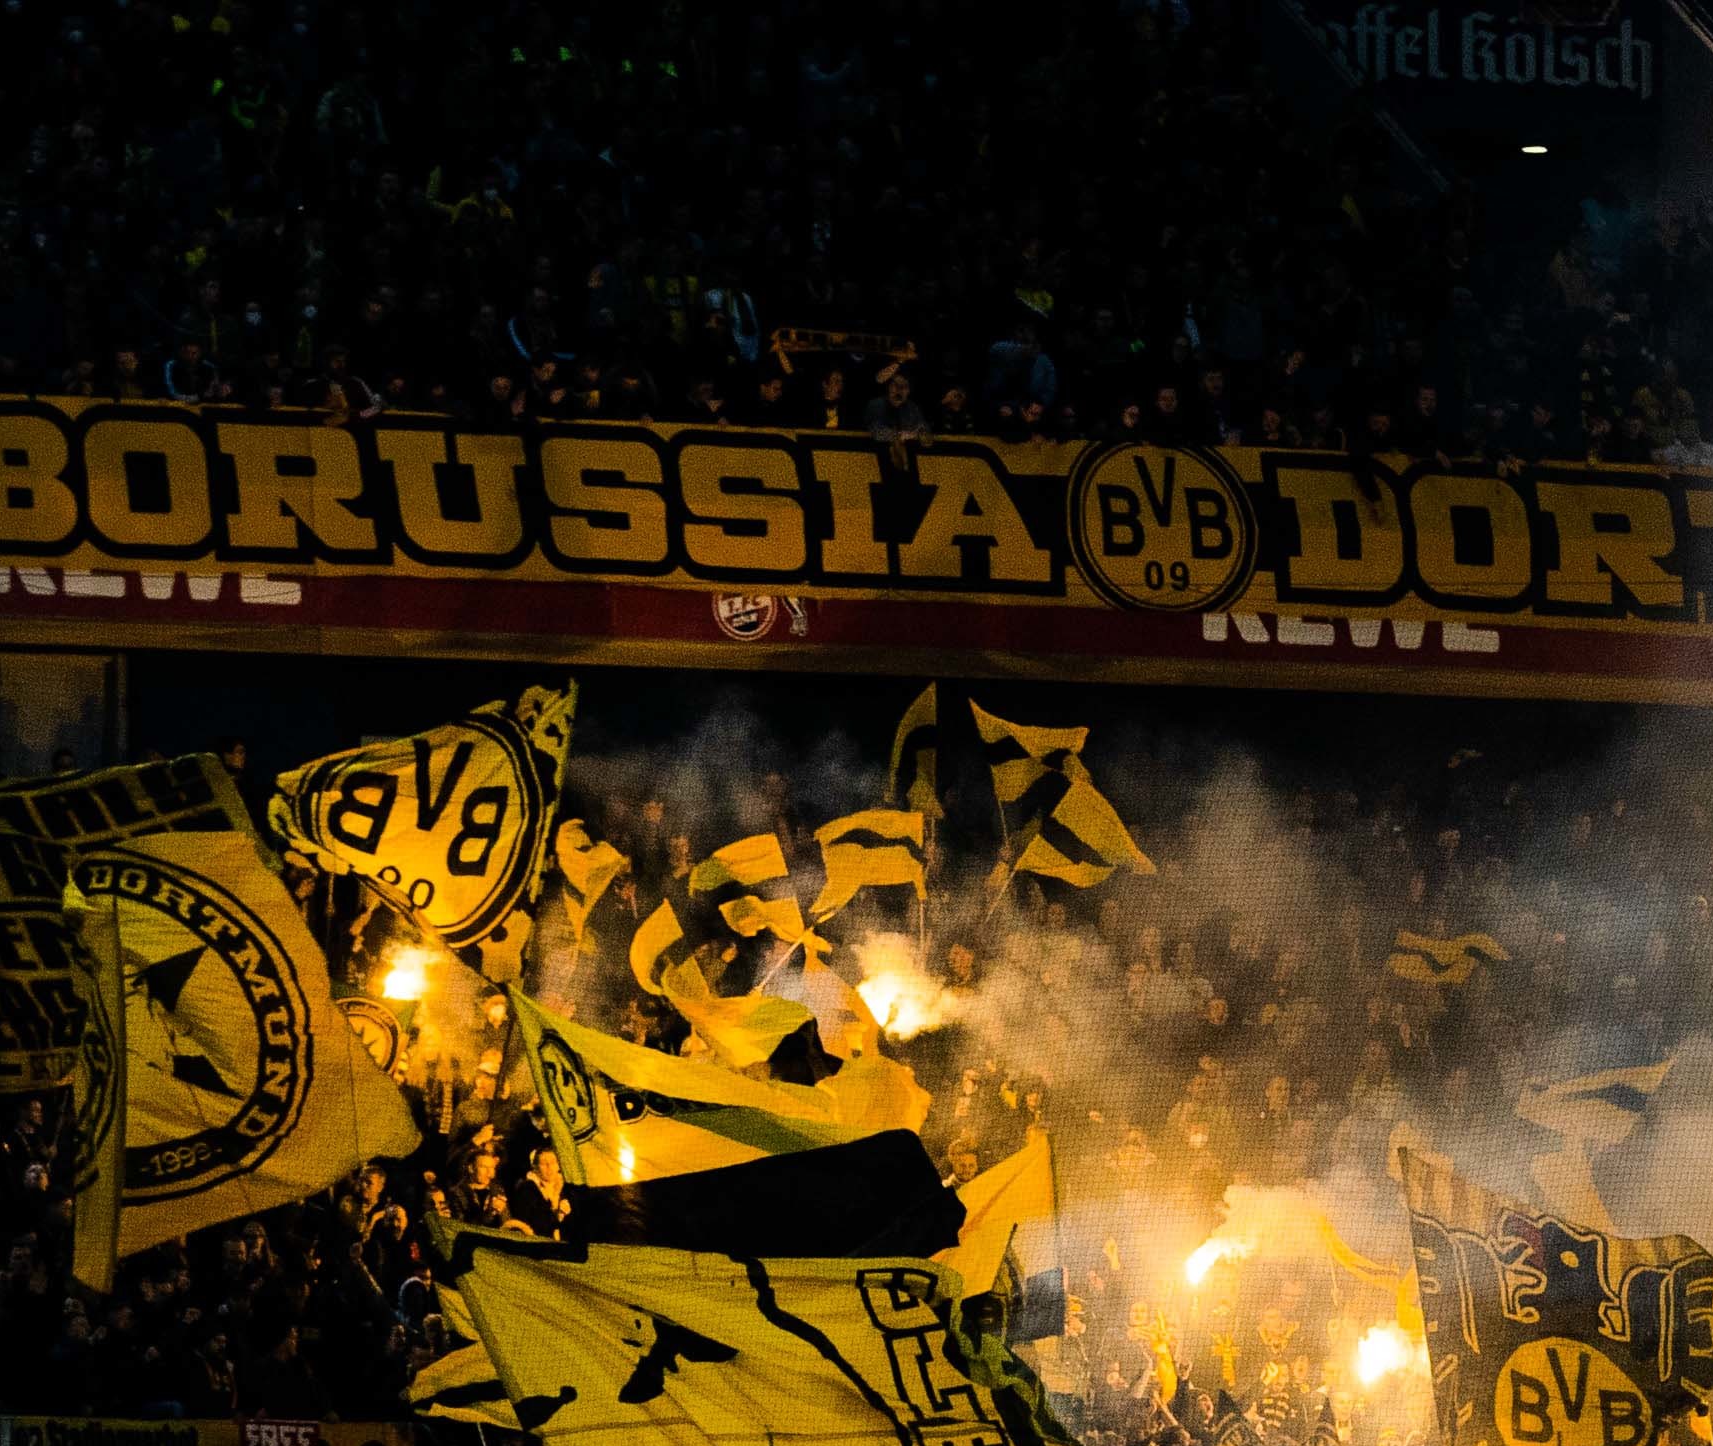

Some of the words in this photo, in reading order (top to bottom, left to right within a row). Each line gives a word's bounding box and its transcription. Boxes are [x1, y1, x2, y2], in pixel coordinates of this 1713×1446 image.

[1098, 452, 1238, 560] BVB
[1142, 560, 1192, 590] 09
[83, 862, 294, 1140] DORTMUND
